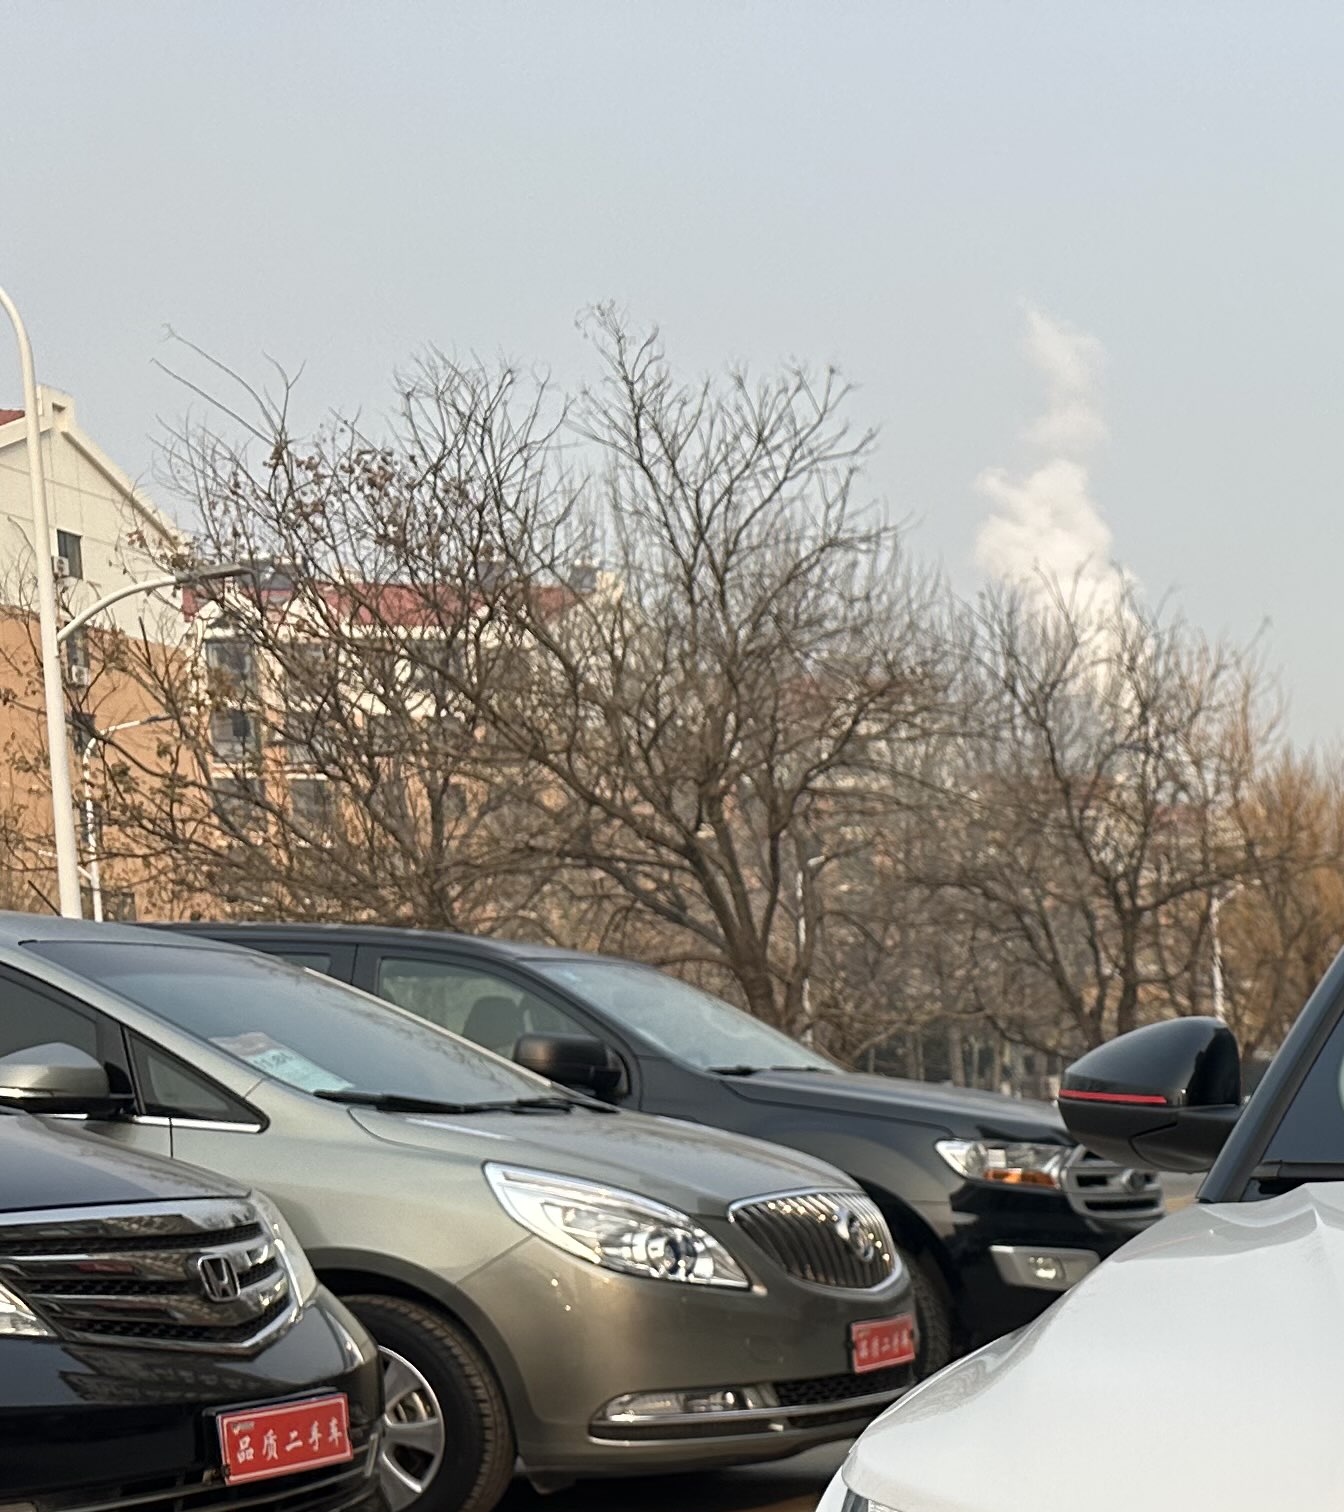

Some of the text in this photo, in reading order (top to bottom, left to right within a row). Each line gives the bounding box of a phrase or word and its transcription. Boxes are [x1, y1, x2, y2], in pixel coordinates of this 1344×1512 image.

[236, 1416, 343, 1465] 品质二手车
